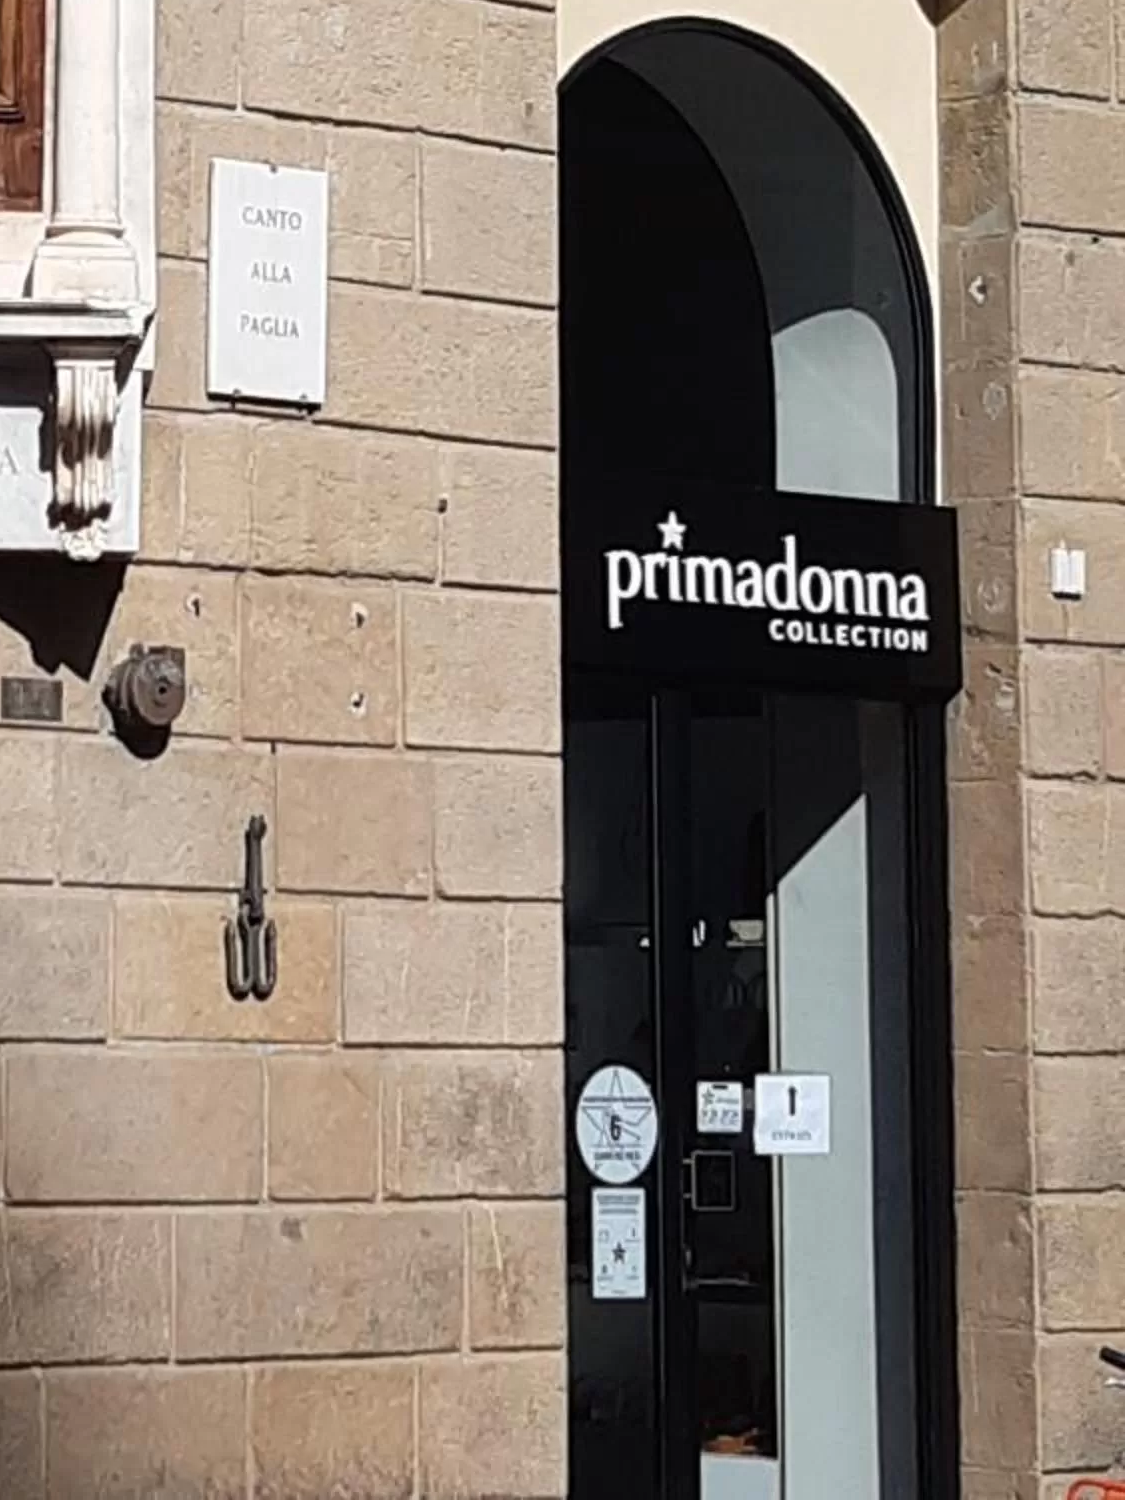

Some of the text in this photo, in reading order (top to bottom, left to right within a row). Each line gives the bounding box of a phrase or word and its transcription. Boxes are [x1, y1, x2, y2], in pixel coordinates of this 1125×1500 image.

[241, 206, 303, 232] CANTO
[250, 261, 293, 284] ALLA
[239, 314, 300, 339] PAGLIA
[604, 510, 930, 630] primadonna
[768, 617, 930, 653] COLLECTION
